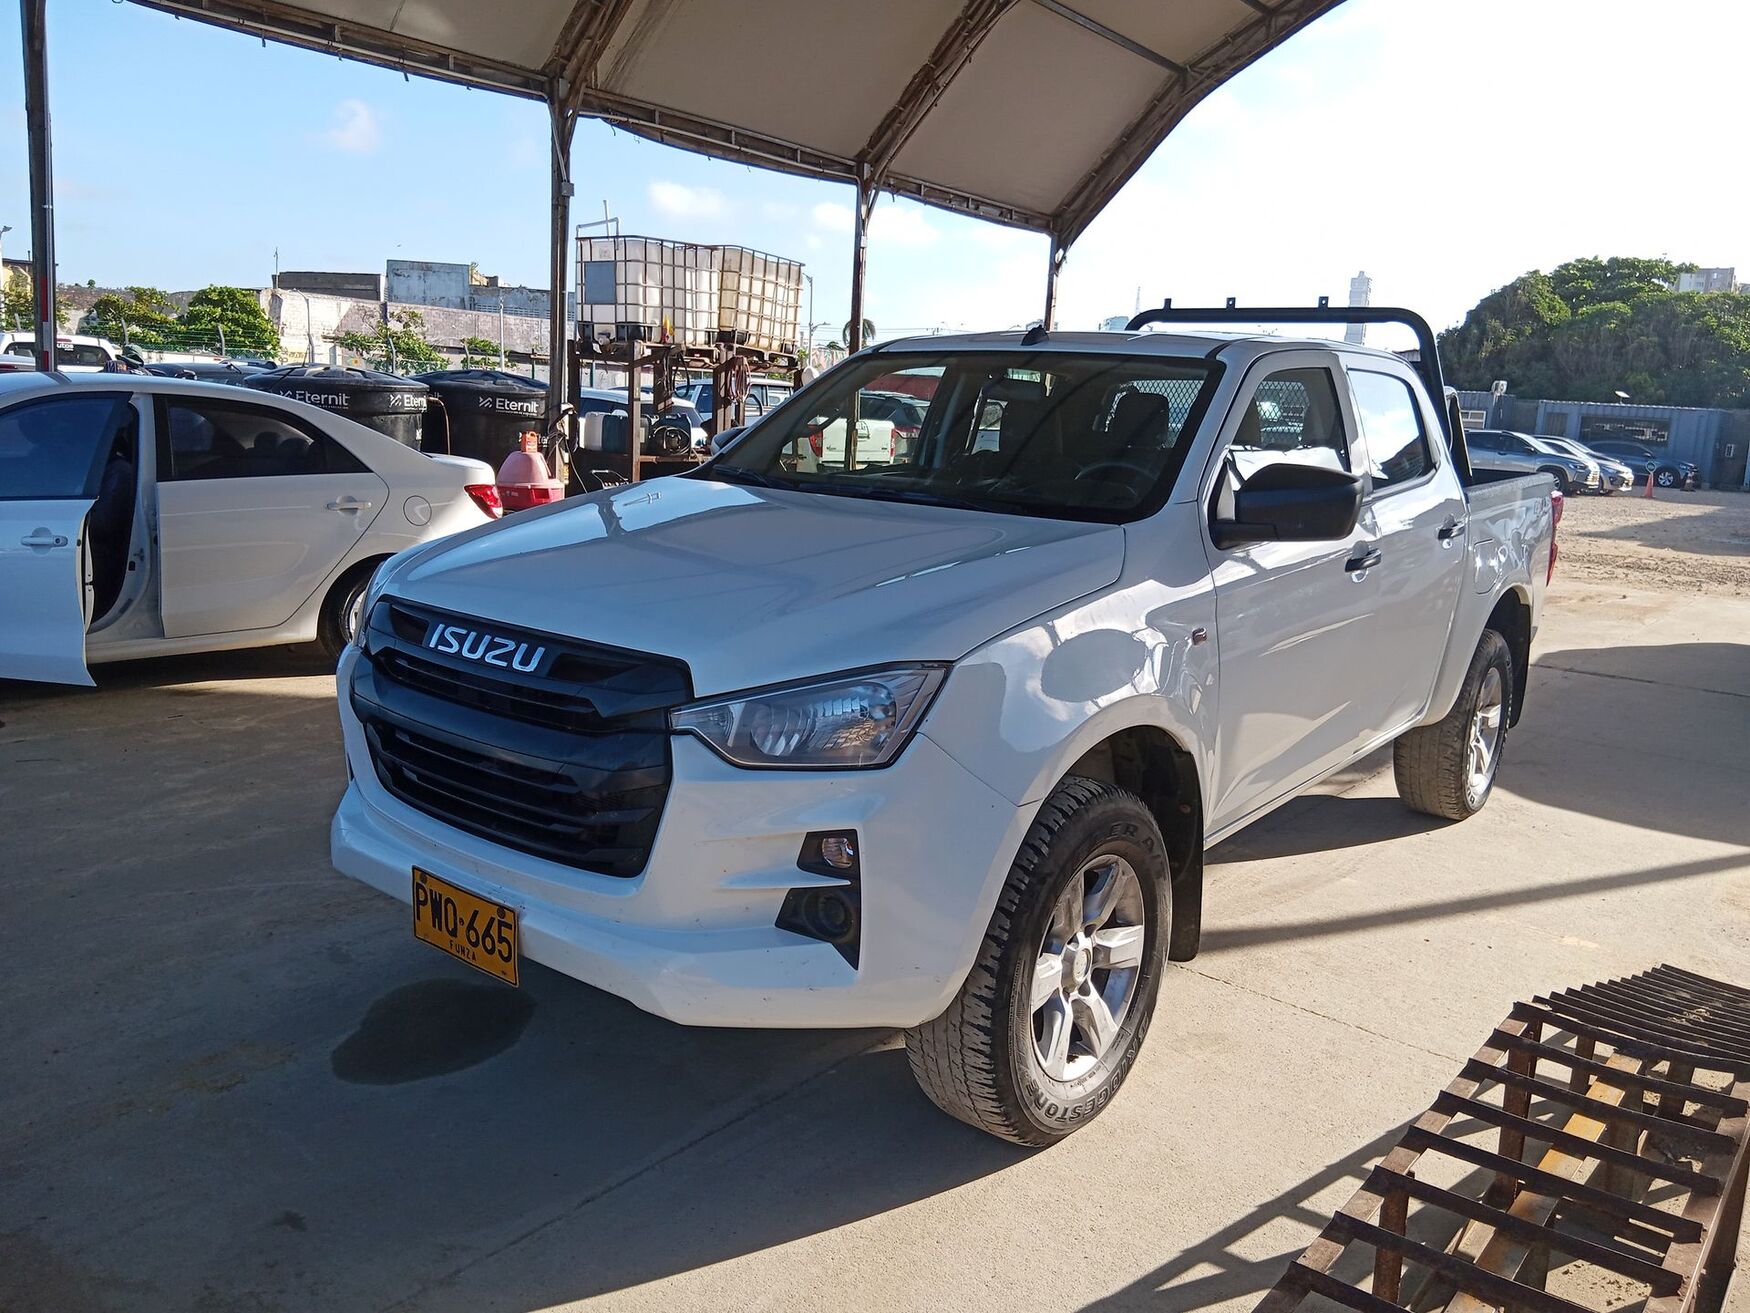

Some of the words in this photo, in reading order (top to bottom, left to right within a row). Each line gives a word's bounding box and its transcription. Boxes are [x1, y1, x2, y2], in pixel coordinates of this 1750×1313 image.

[296, 391, 350, 406] Eternit
[404, 394, 427, 407] Eterni
[496, 398, 539, 412] Eternit
[429, 624, 545, 672] ISUZU
[449, 940, 477, 961] FUNZA
